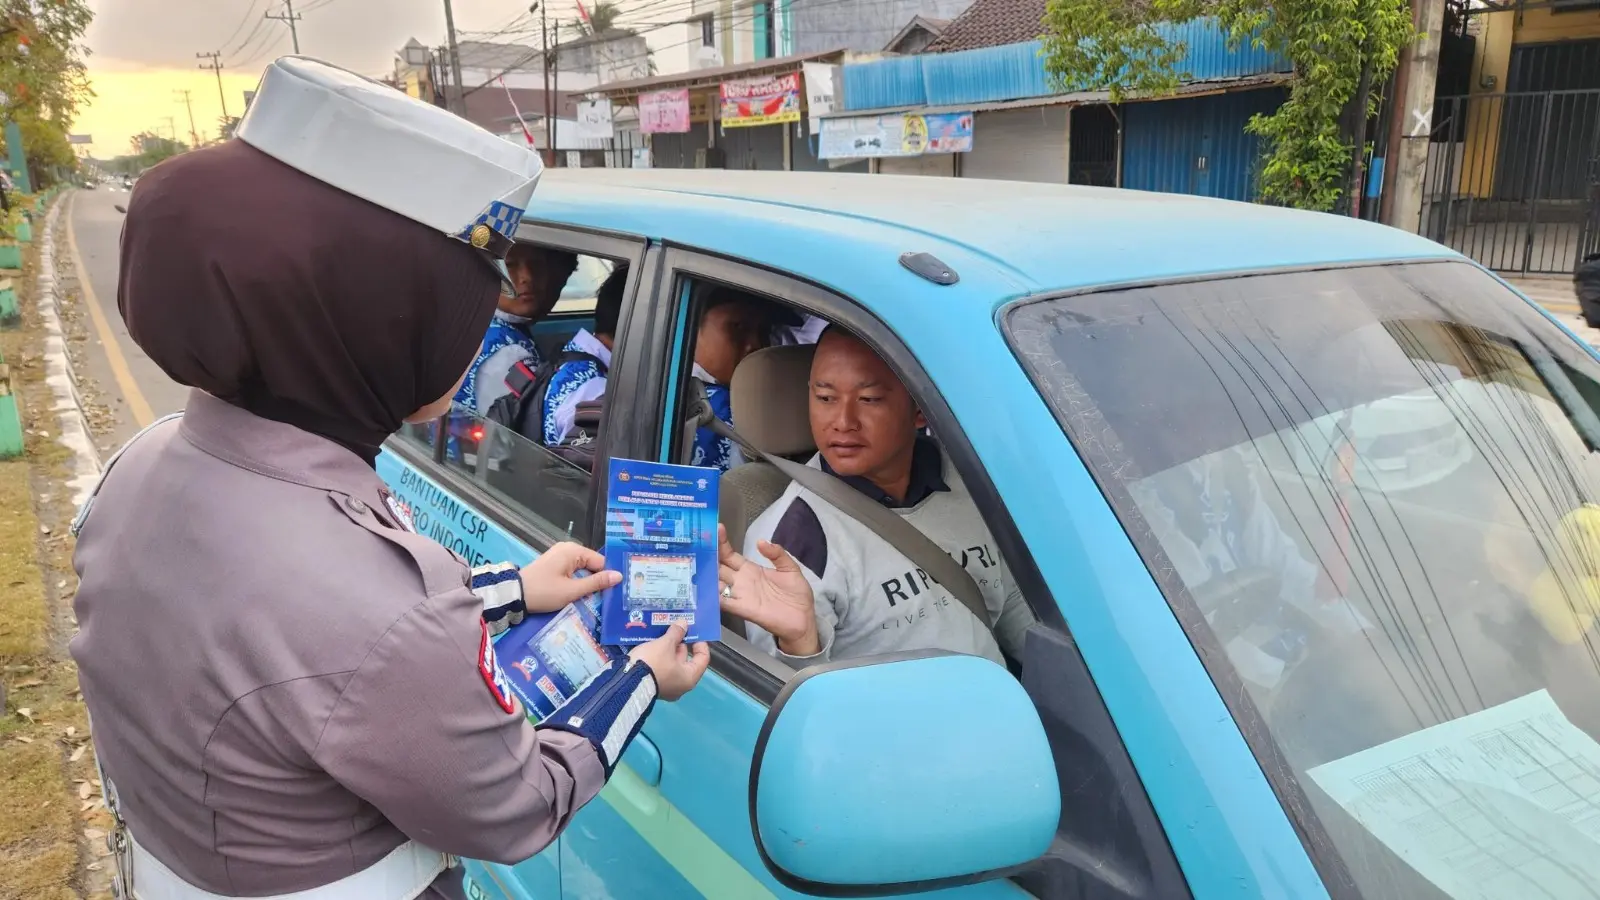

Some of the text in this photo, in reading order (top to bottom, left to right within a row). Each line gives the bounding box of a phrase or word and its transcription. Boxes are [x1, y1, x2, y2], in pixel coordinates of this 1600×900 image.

[400, 467, 489, 543] BANTUAN CSR
[429, 521, 492, 568] INDONE
[881, 568, 930, 607] RIP
[882, 607, 926, 630] LIVE
